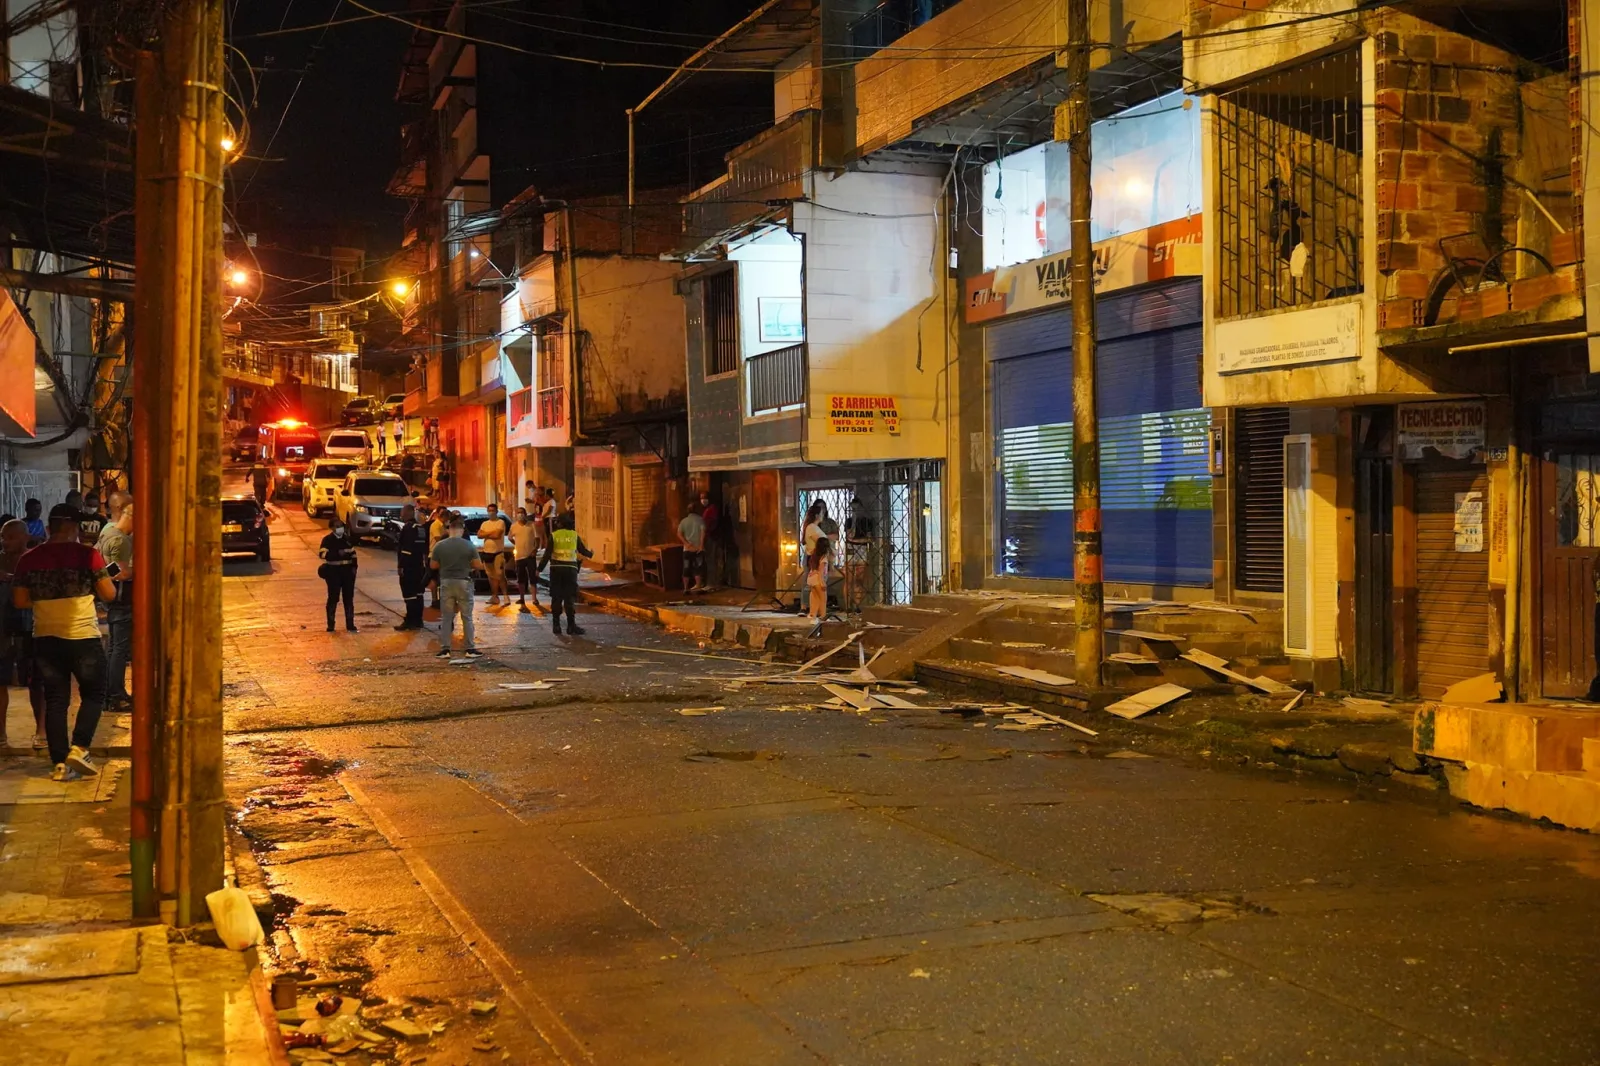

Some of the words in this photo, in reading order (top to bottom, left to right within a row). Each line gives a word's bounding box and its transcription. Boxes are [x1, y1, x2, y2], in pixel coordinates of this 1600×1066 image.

[832, 397, 844, 409] SE
[846, 397, 895, 409] ARRIENDA
[831, 410, 898, 418] APARTAMNTO
